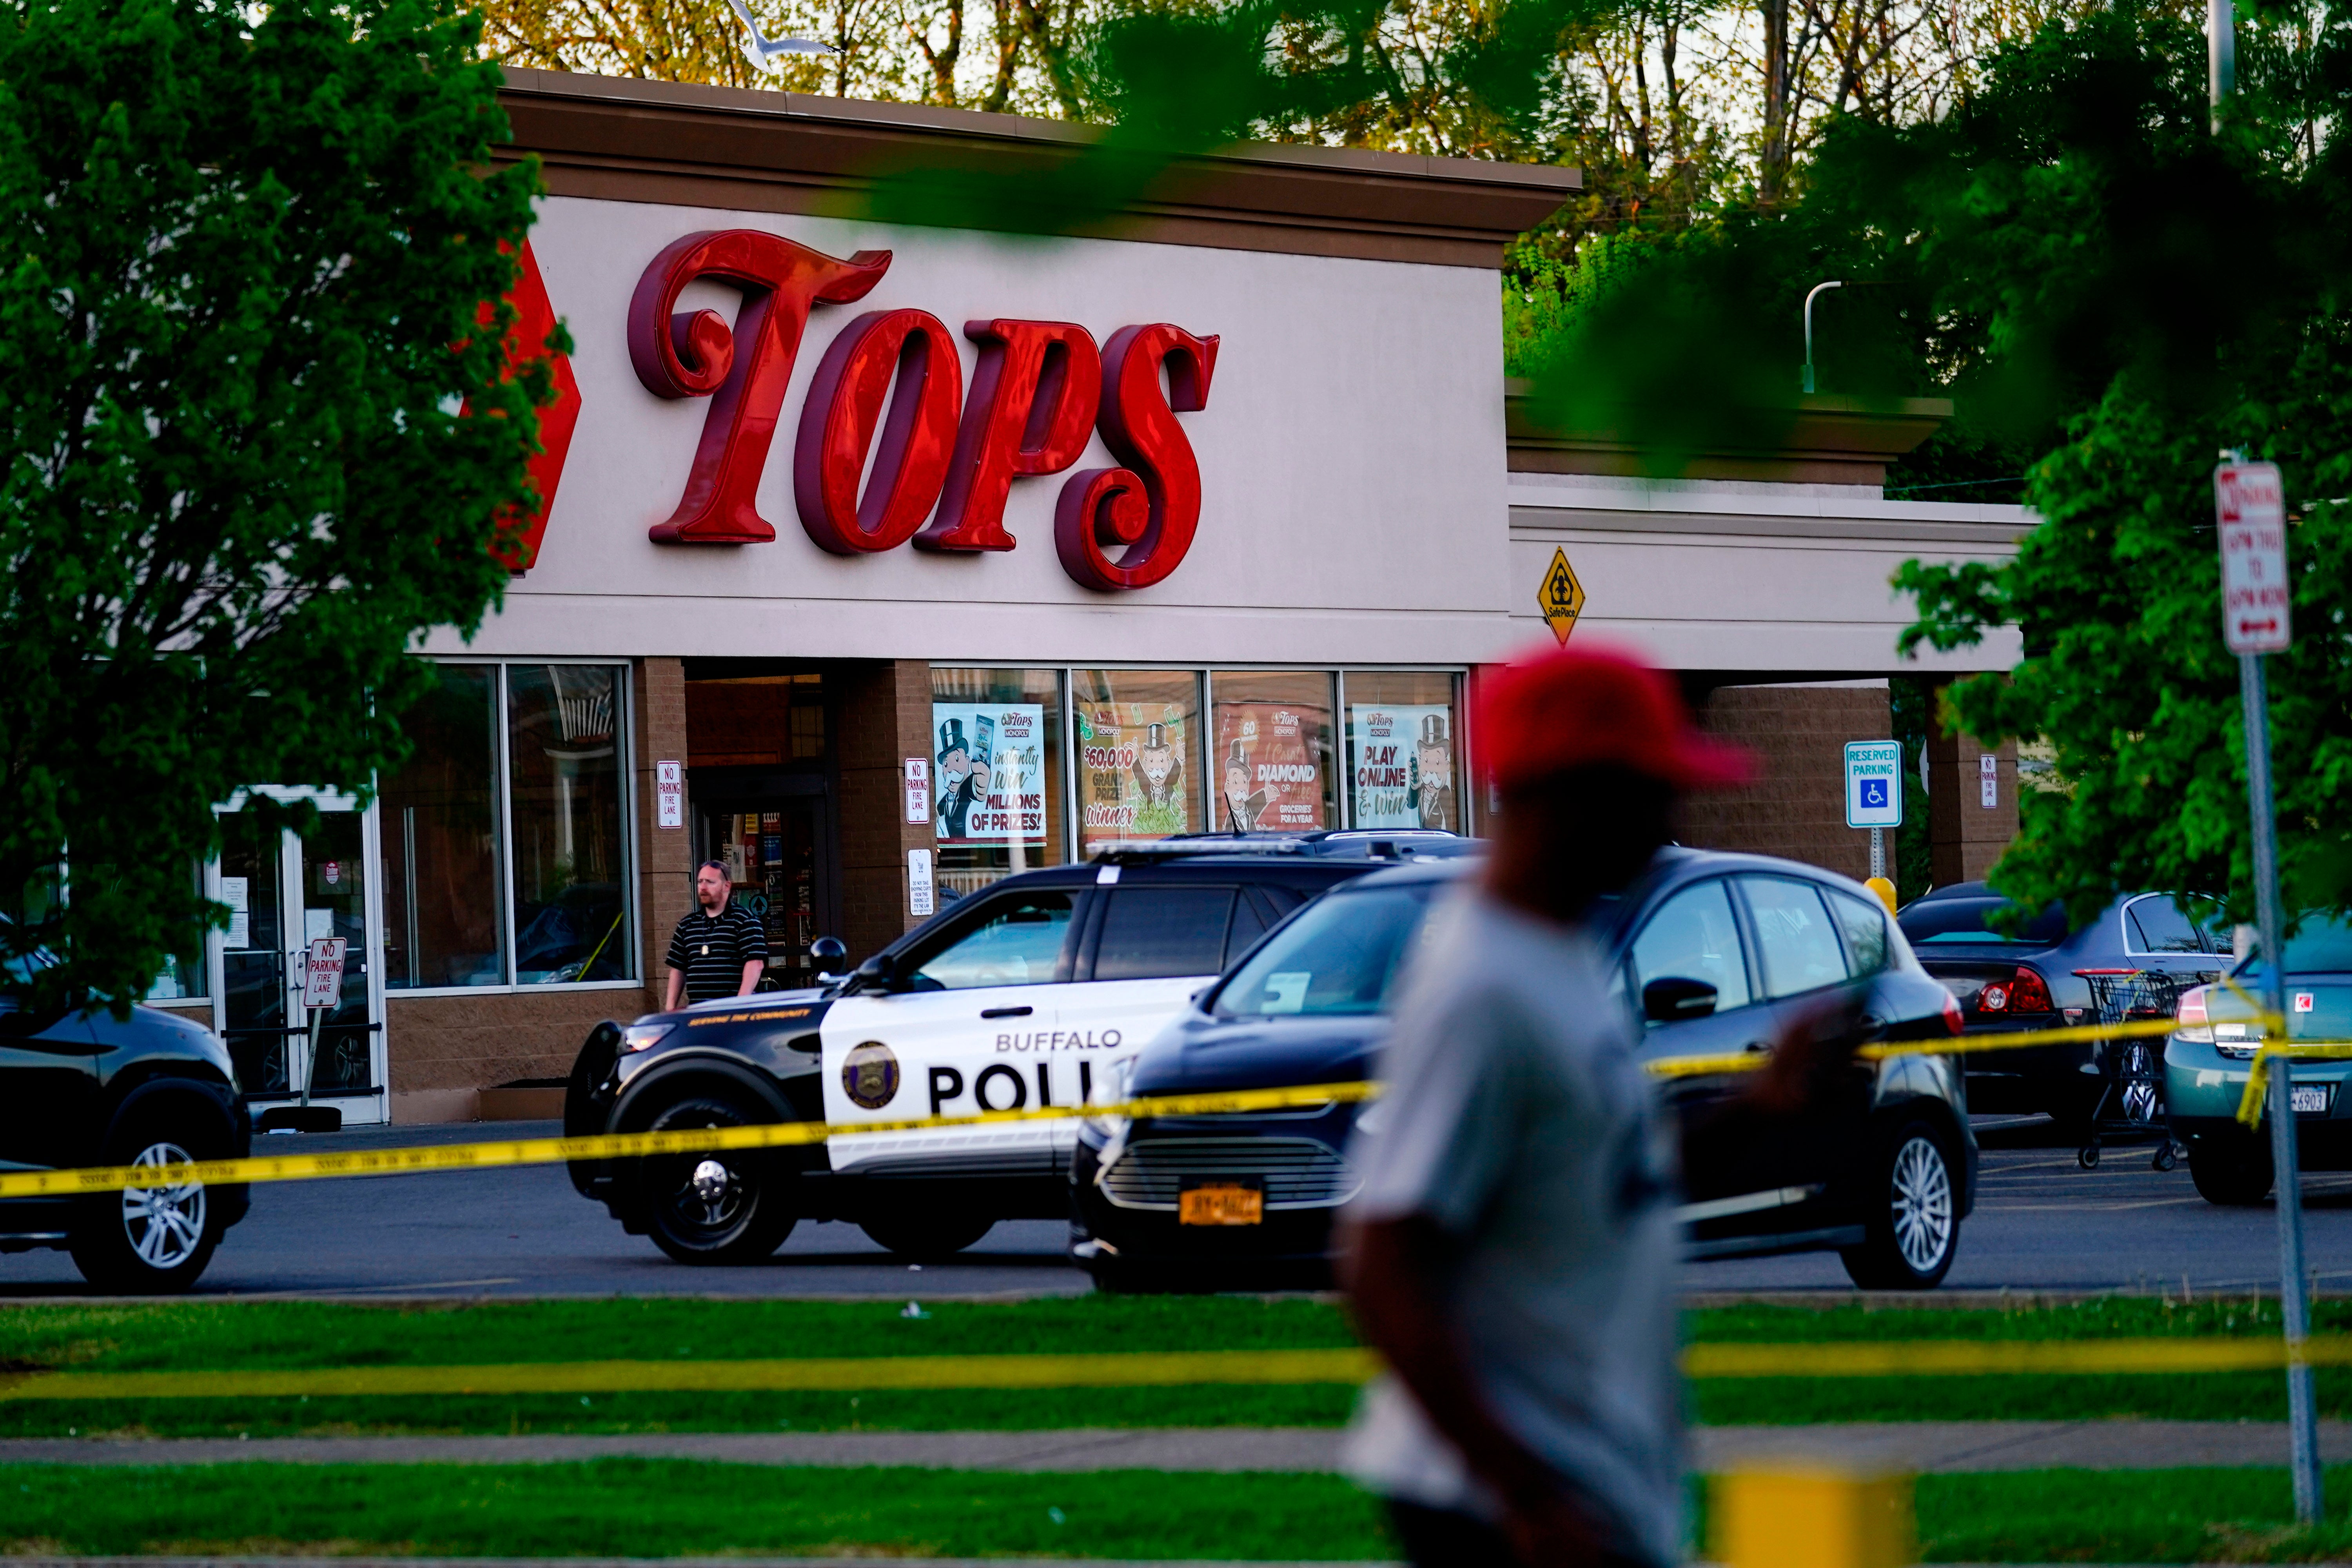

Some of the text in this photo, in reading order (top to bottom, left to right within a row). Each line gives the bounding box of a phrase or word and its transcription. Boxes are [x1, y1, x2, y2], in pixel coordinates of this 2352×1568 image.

[627, 228, 1221, 590] TOPS
[1242, 721, 1255, 736] 60
[995, 745, 1039, 776] instantly
[1084, 746, 1134, 771] $60,000
[1364, 746, 1397, 765] PLAY
[1849, 750, 1895, 761] RESERVED
[912, 765, 921, 777] NO
[1853, 764, 1893, 775] PARKING
[1985, 760, 1991, 770] NO
[664, 767, 674, 780] NO
[1257, 764, 1316, 782] DIAMOND
[1357, 767, 1406, 787] ONLINE
[660, 782, 680, 795] PARKING
[907, 779, 927, 791] PARKING
[1281, 784, 1291, 792] OR
[665, 796, 675, 804] FIRE
[912, 802, 923, 810] LANE
[985, 794, 1041, 810] MILLIONS
[1358, 789, 1371, 820] &
[664, 806, 676, 815] LANE
[1279, 804, 1312, 814] GROCERIES
[971, 813, 1042, 831] OF PRIZES!
[1280, 814, 1313, 824] FOR A YEAR
[321, 944, 335, 957] NO
[310, 960, 341, 972] PARKING
[317, 974, 332, 983] FIRE
[314, 984, 331, 993] LANE
[996, 1029, 1122, 1053] BUFFALO
[929, 1061, 1092, 1114] POLI
[2298, 1094, 2322, 1110] 6903
